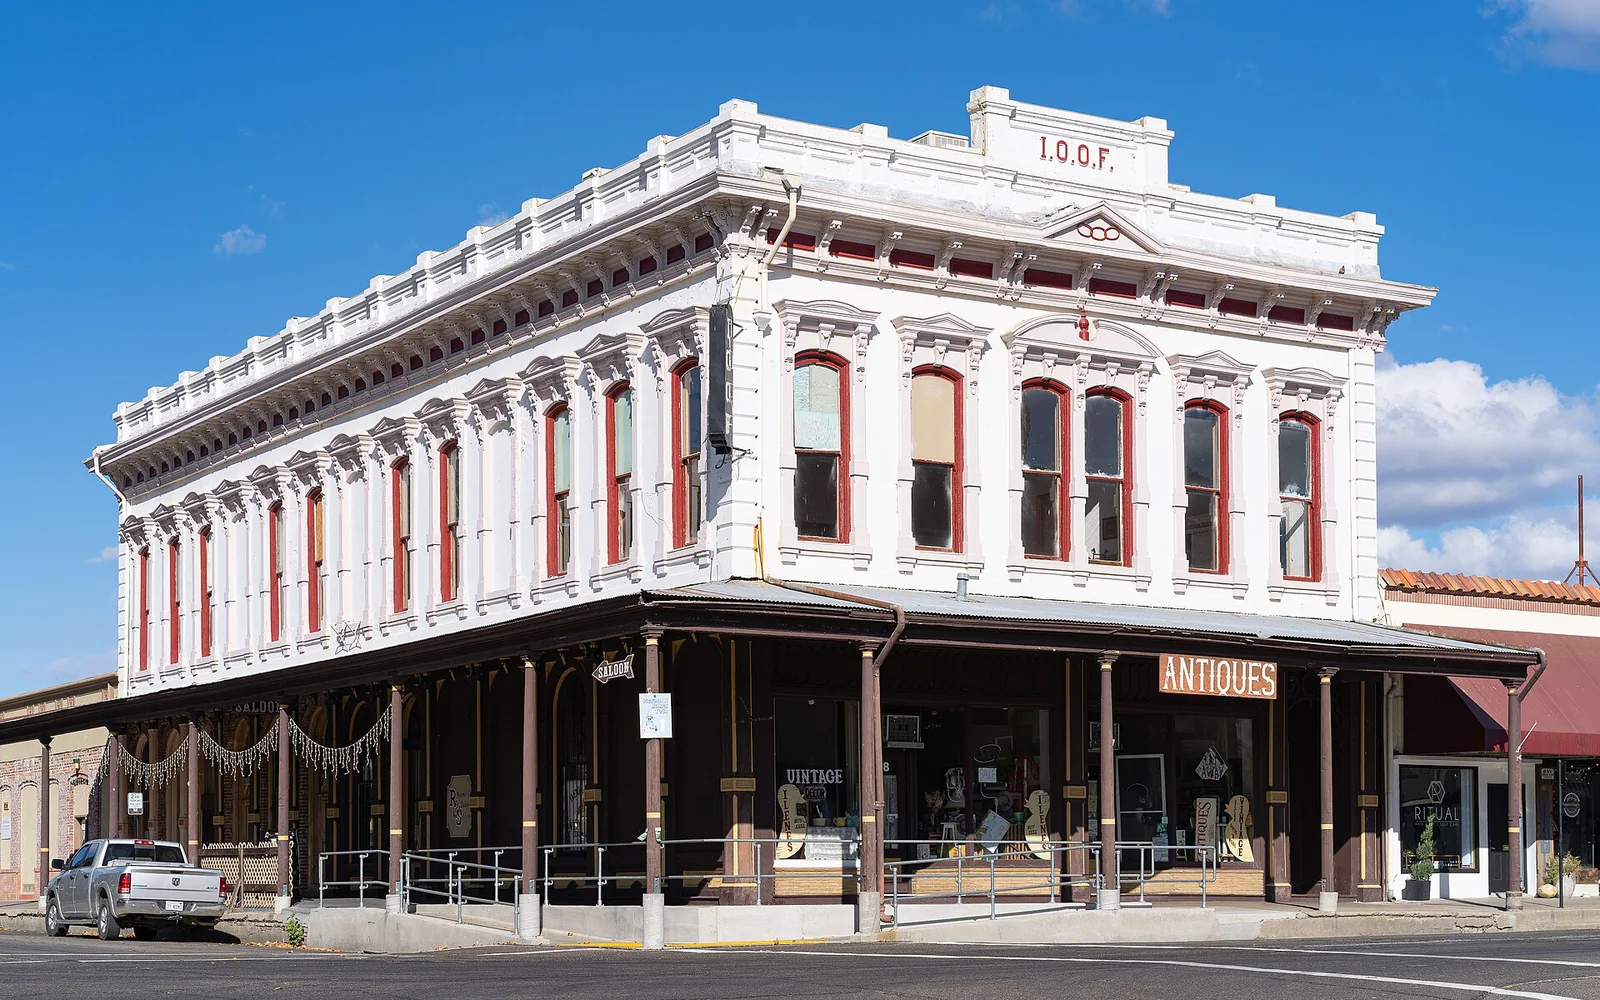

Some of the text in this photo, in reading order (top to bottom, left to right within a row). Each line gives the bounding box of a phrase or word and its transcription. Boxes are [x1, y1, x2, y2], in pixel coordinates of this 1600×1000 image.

[1041, 136, 1113, 171] I.O.O.F.
[598, 661, 630, 678] SALOON
[1163, 656, 1275, 696] ANTIQUES
[786, 769, 844, 784] VINTAGE
[804, 788, 825, 799] DECOR
[1414, 806, 1459, 821] RITUAL
